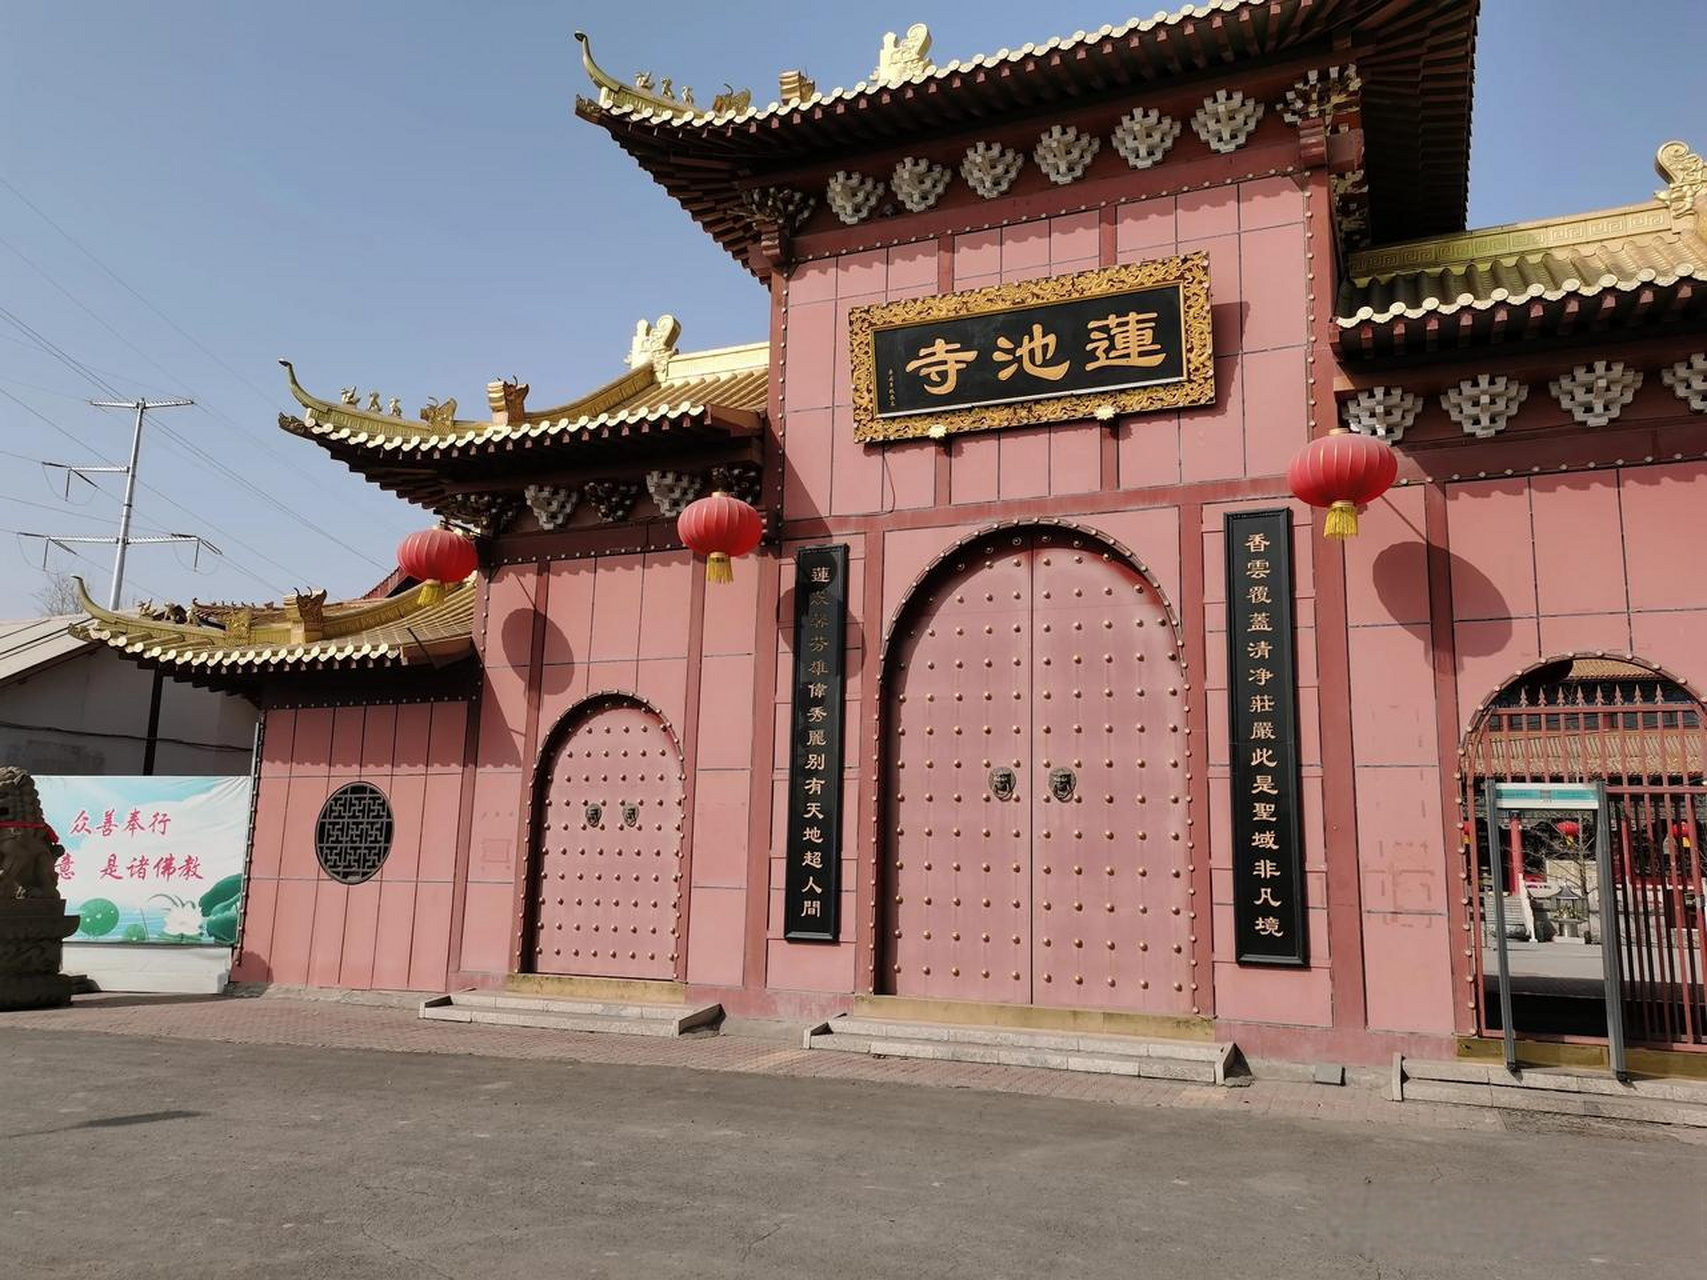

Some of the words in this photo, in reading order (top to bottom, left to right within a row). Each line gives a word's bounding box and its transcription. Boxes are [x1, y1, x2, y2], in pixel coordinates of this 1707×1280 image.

[905, 311, 1168, 396] 蓮池寺
[70, 809, 171, 837] 众善奉行
[99, 853, 204, 881] 是诸佛教
